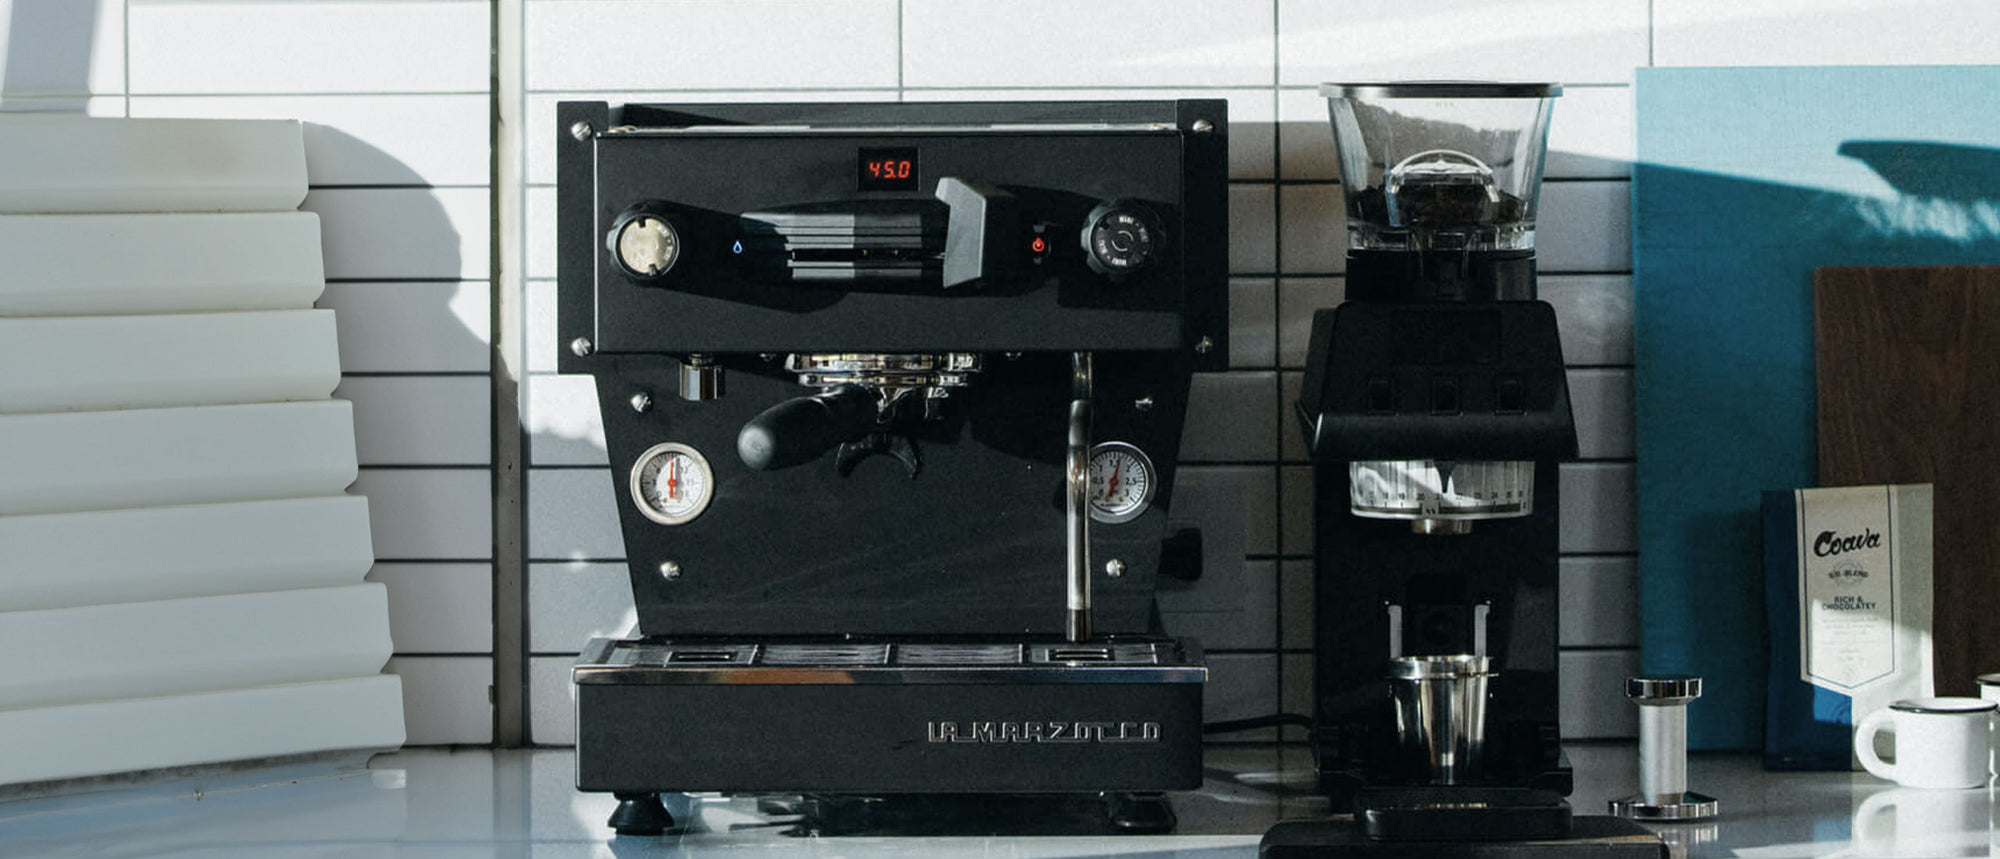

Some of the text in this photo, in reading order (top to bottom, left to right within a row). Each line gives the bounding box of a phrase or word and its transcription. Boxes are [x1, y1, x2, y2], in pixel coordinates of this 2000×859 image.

[868, 160, 911, 179] 45.0
[1813, 528, 1881, 557] Coava
[1821, 602, 1876, 611] CHOCOLATEY
[1834, 595, 1855, 603] RICH
[928, 722, 955, 742] LA
